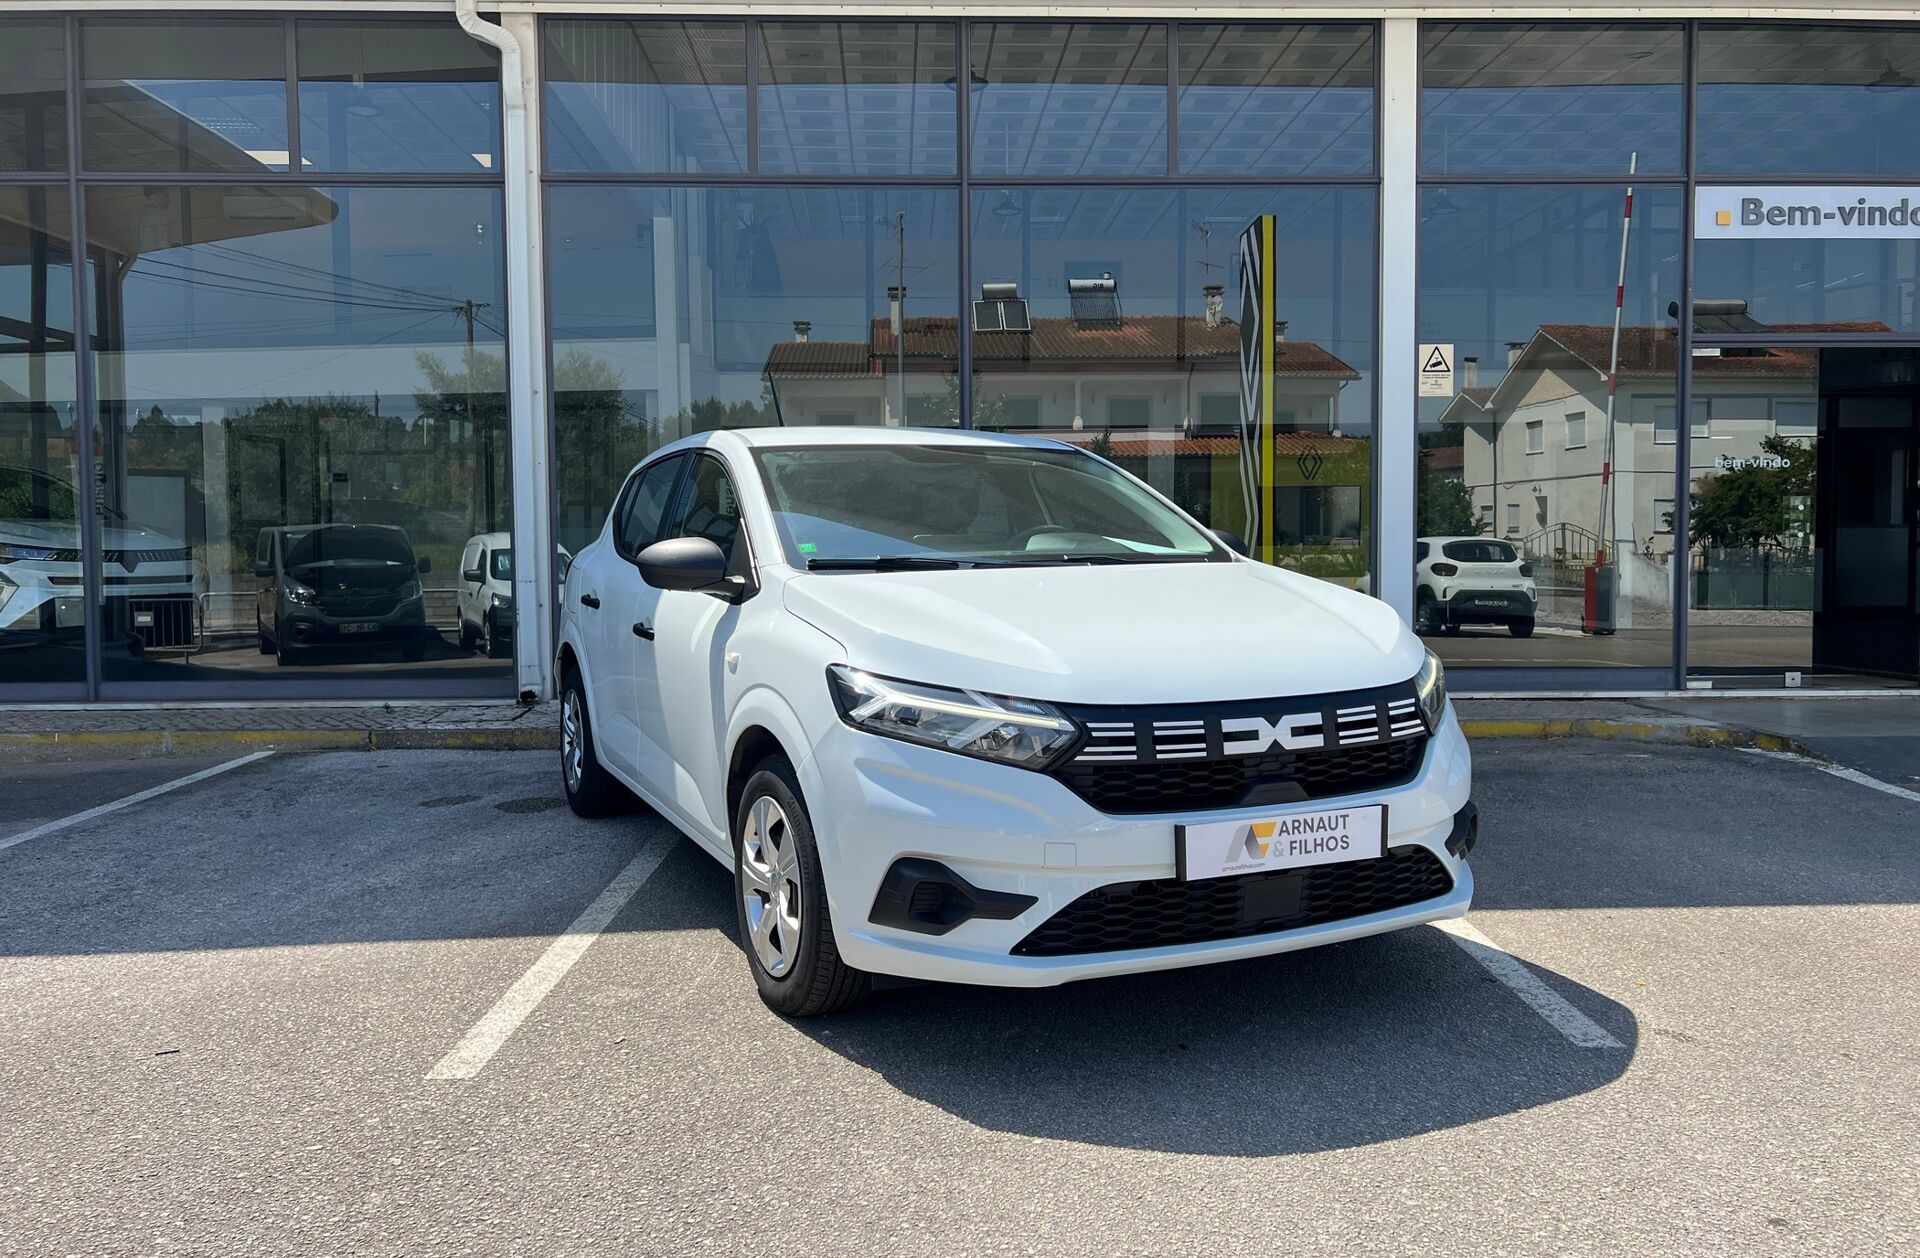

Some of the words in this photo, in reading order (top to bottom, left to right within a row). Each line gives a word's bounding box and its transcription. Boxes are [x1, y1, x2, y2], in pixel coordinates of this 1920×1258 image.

[1714, 457, 1791, 469] bem-vindo
[1278, 813, 1350, 837] ARNAUT
[1272, 840, 1284, 858] &
[1289, 834, 1350, 856] FILHOS
